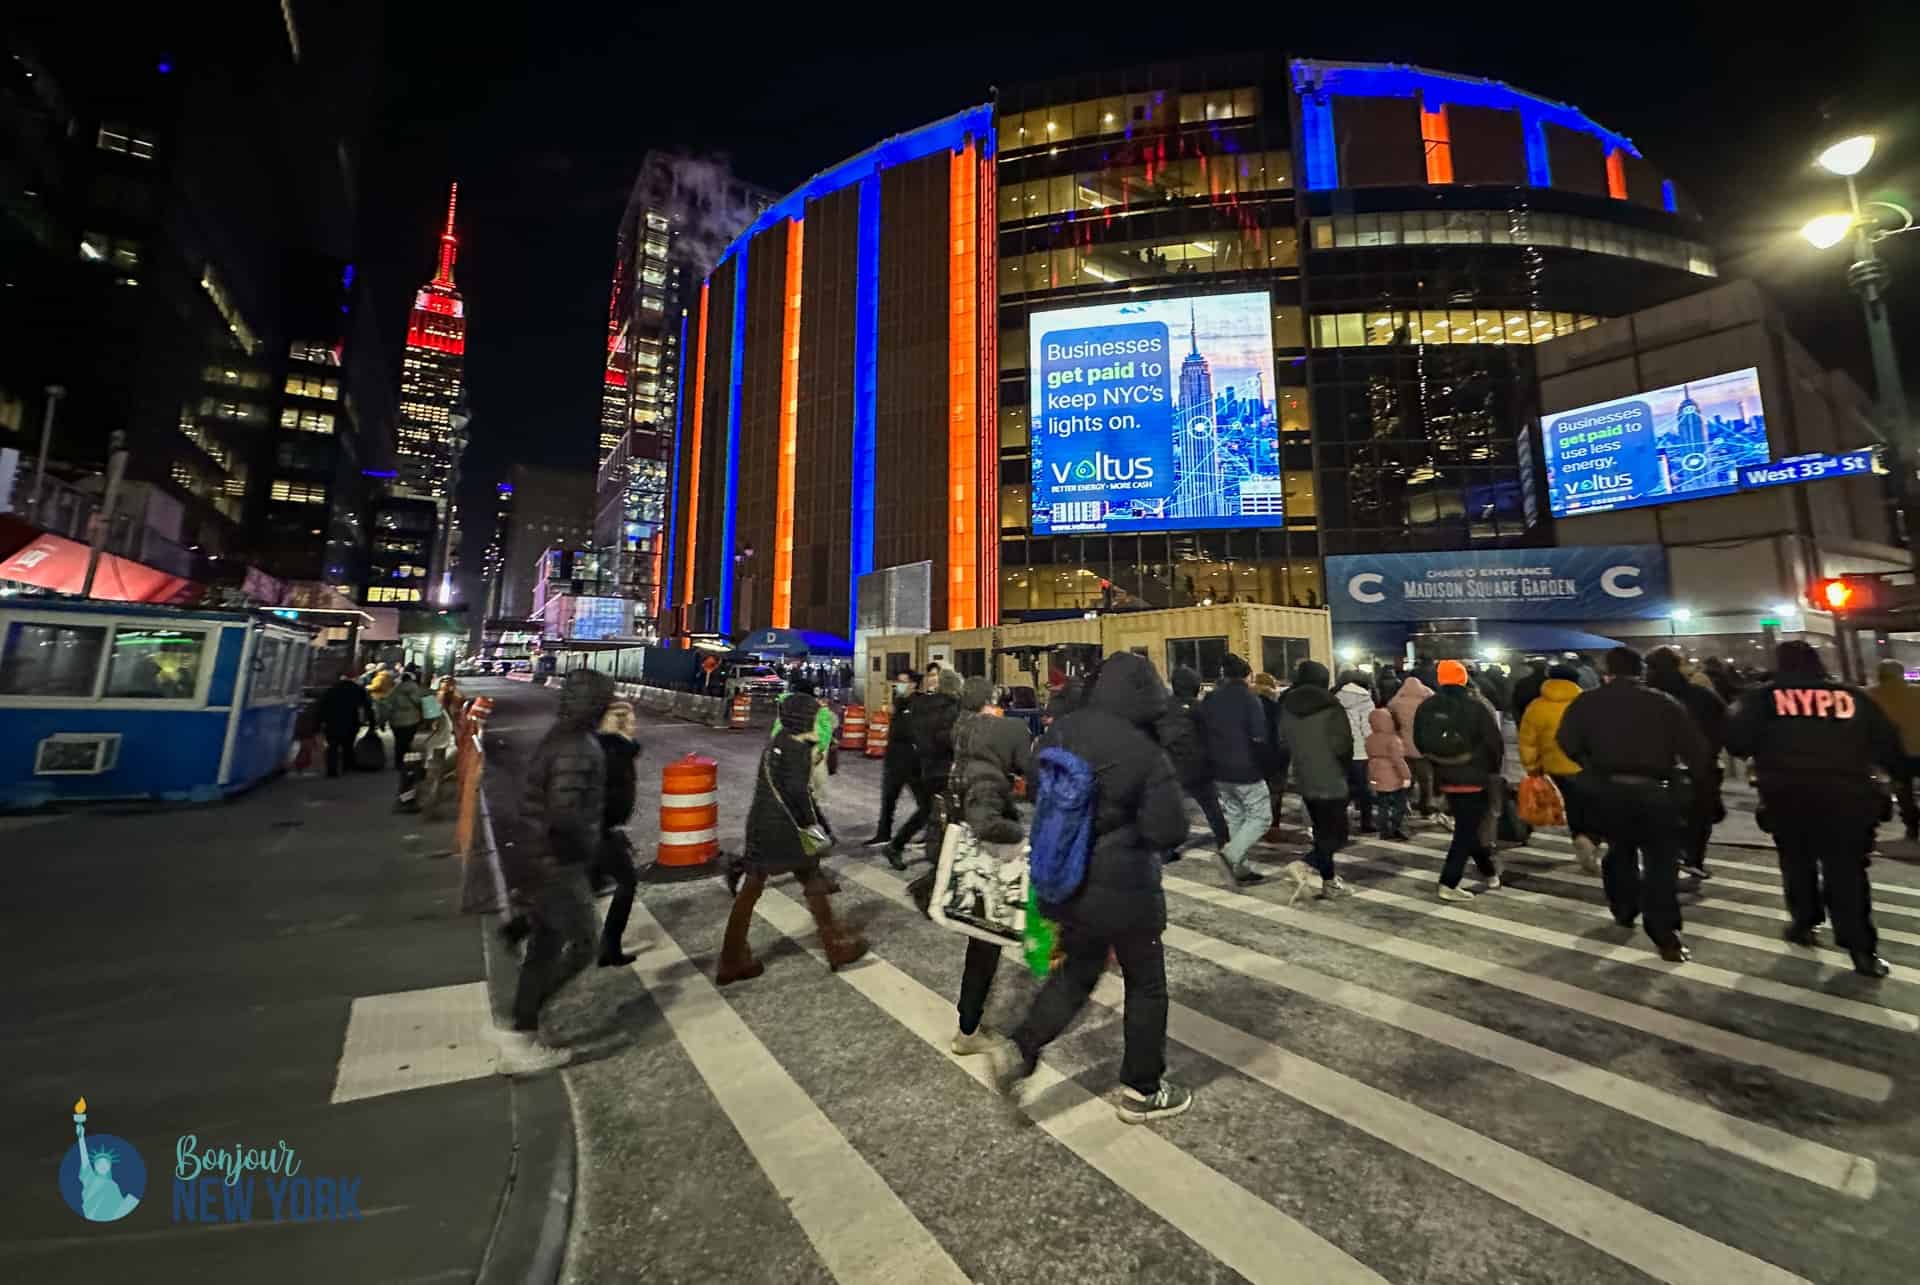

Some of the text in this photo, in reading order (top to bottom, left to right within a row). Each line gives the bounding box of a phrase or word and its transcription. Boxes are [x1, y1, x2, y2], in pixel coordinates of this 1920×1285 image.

[1048, 337, 1161, 361] Businesses
[1048, 360, 1162, 389] get paid to
[1048, 385, 1164, 410] keep NYC's
[1049, 414, 1141, 437] lights on.
[1558, 407, 1643, 434] Businesses
[1560, 422, 1643, 449] get paid to
[1561, 441, 1621, 460] use less
[1051, 451, 1154, 484] voltus
[1562, 456, 1618, 473] energy.
[1746, 466, 1797, 484] West
[1841, 456, 1867, 471] St
[1132, 481, 1153, 489] CASH
[1563, 473, 1633, 494] voltus
[1426, 567, 1553, 578] CHASE ENTRANCE
[1600, 565, 1643, 598] C
[1348, 573, 1385, 603] C
[1404, 578, 1577, 599] MADISON SQUARE GARDEN
[767, 632, 776, 643] D
[1774, 688, 1856, 719] NYPD
